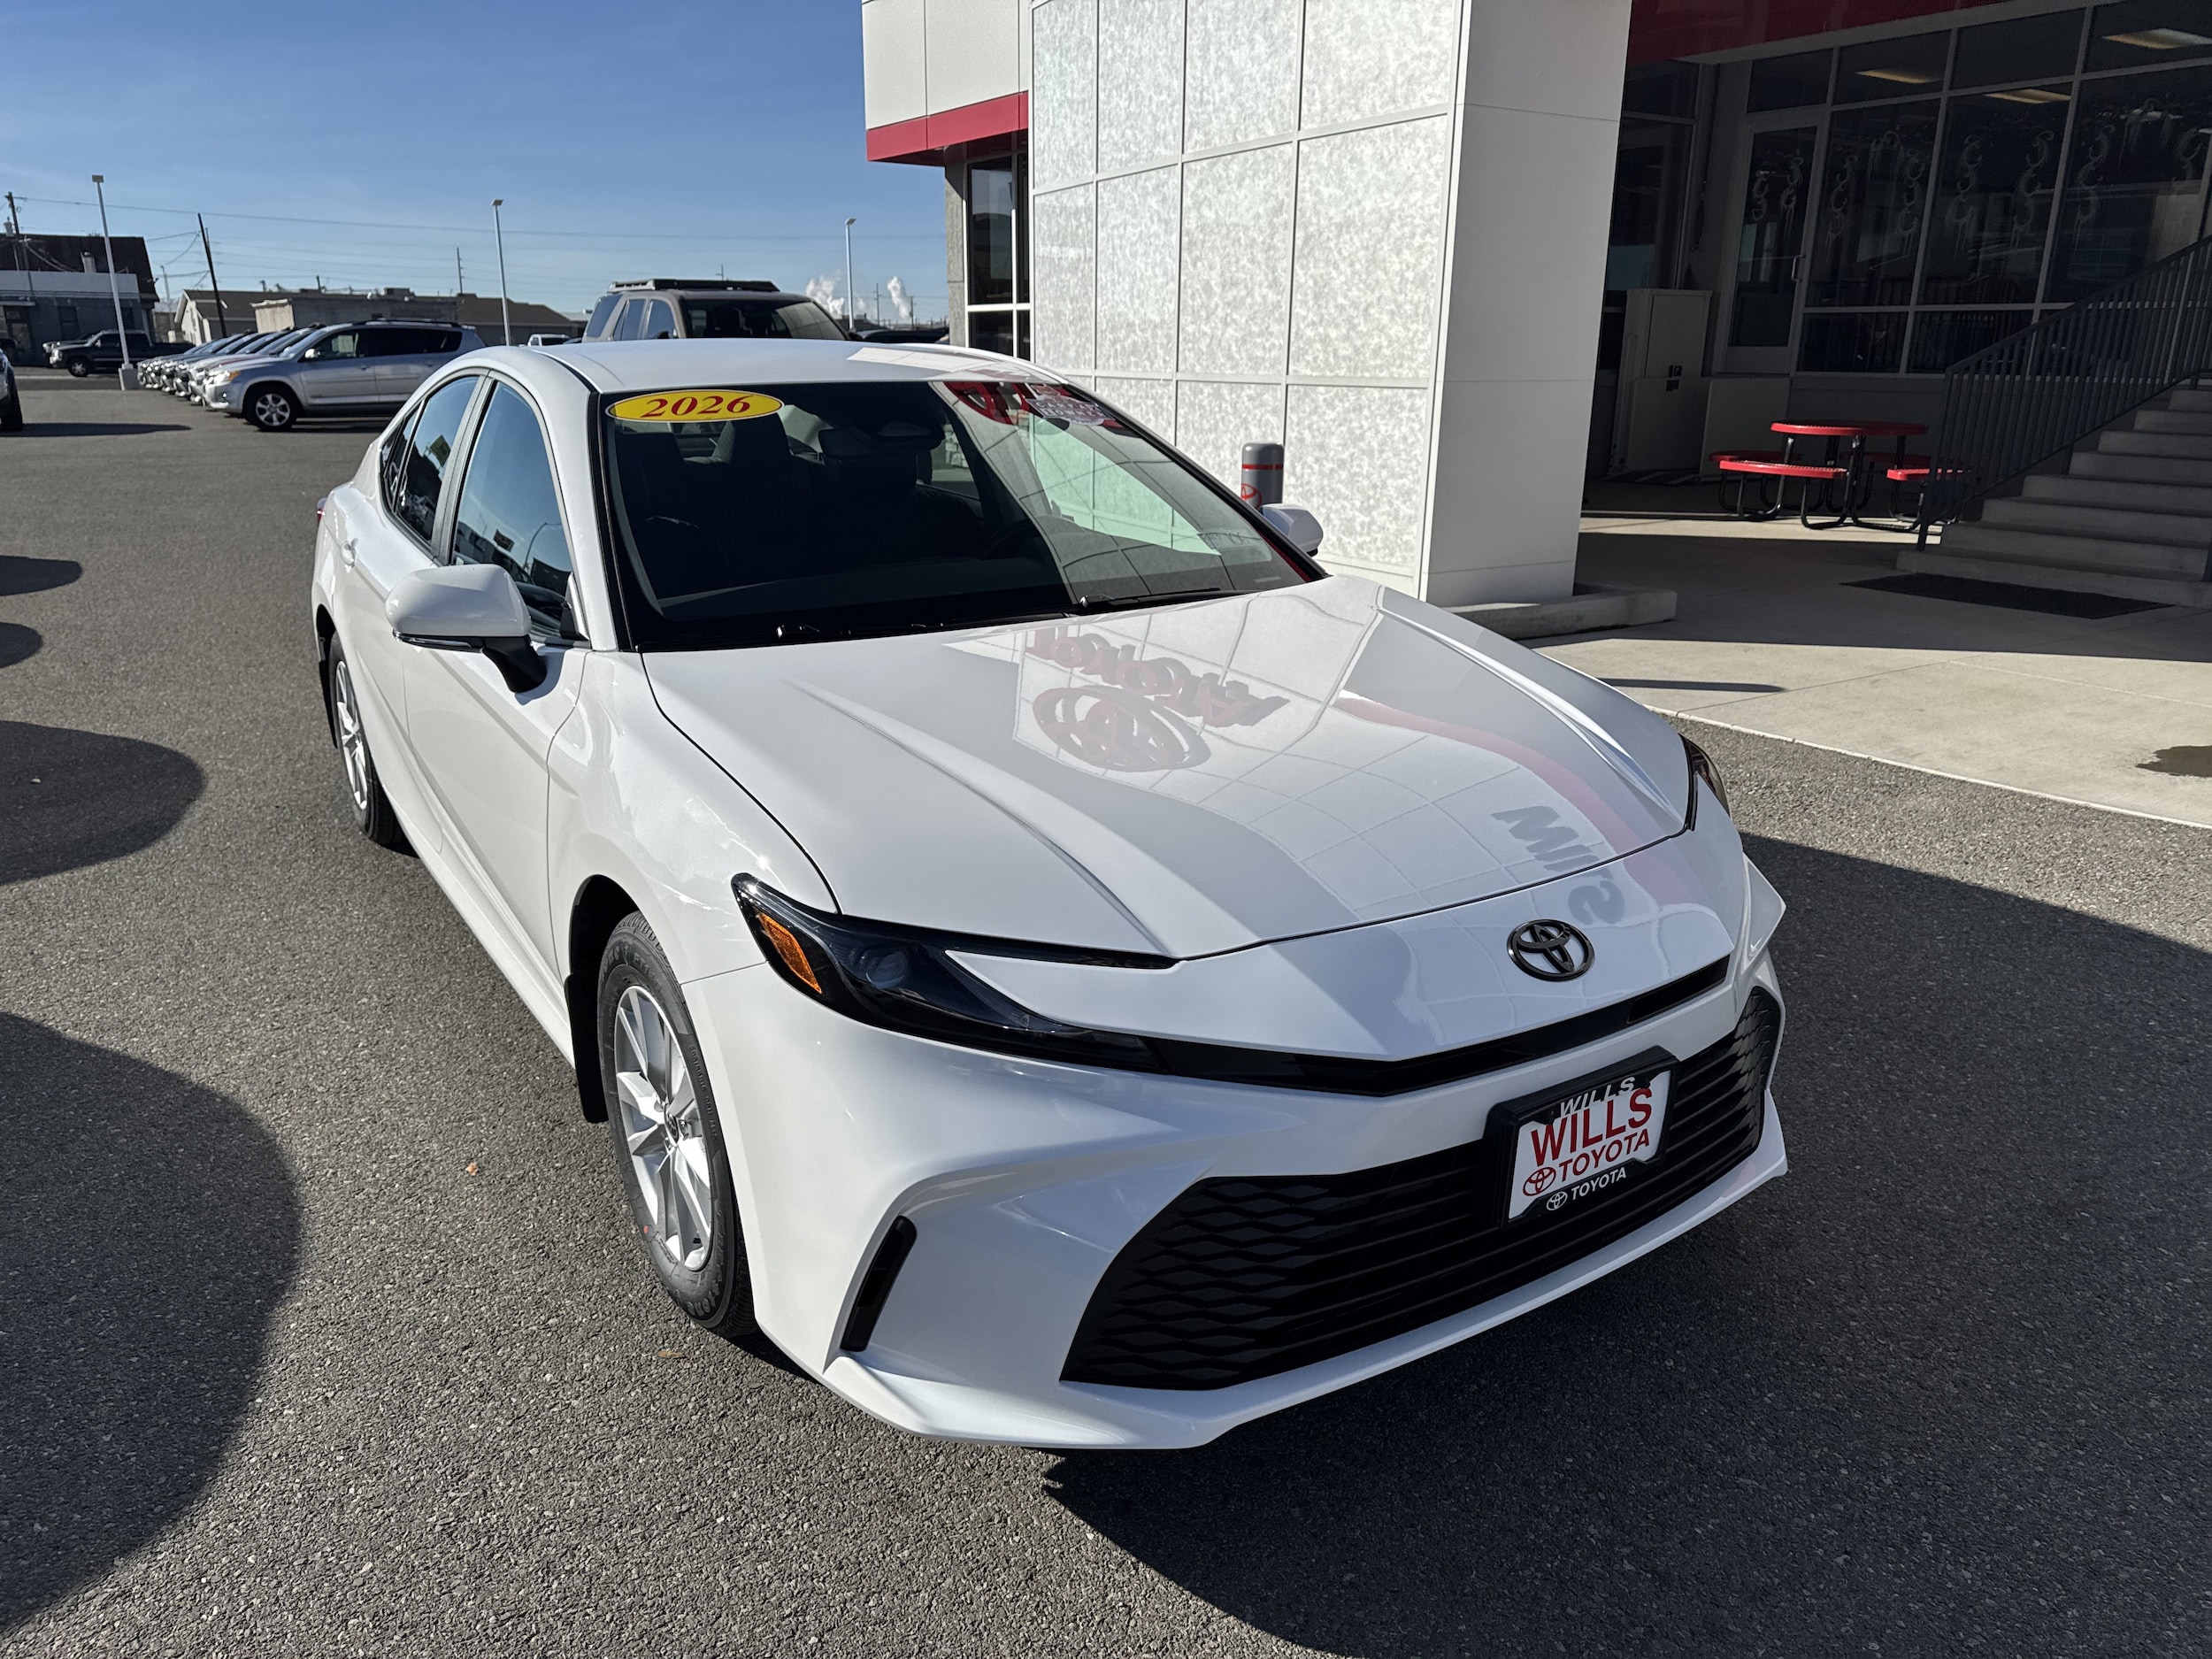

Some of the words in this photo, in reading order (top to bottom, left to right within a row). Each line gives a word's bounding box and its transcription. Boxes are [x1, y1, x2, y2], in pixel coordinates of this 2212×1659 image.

[640, 396, 754, 418] 2026
[1560, 1076, 1635, 1116] WILLS
[1531, 1087, 1653, 1167] WILLS
[1558, 1128, 1650, 1182] TOYOTA
[1571, 1166, 1627, 1201] TOYOTA
